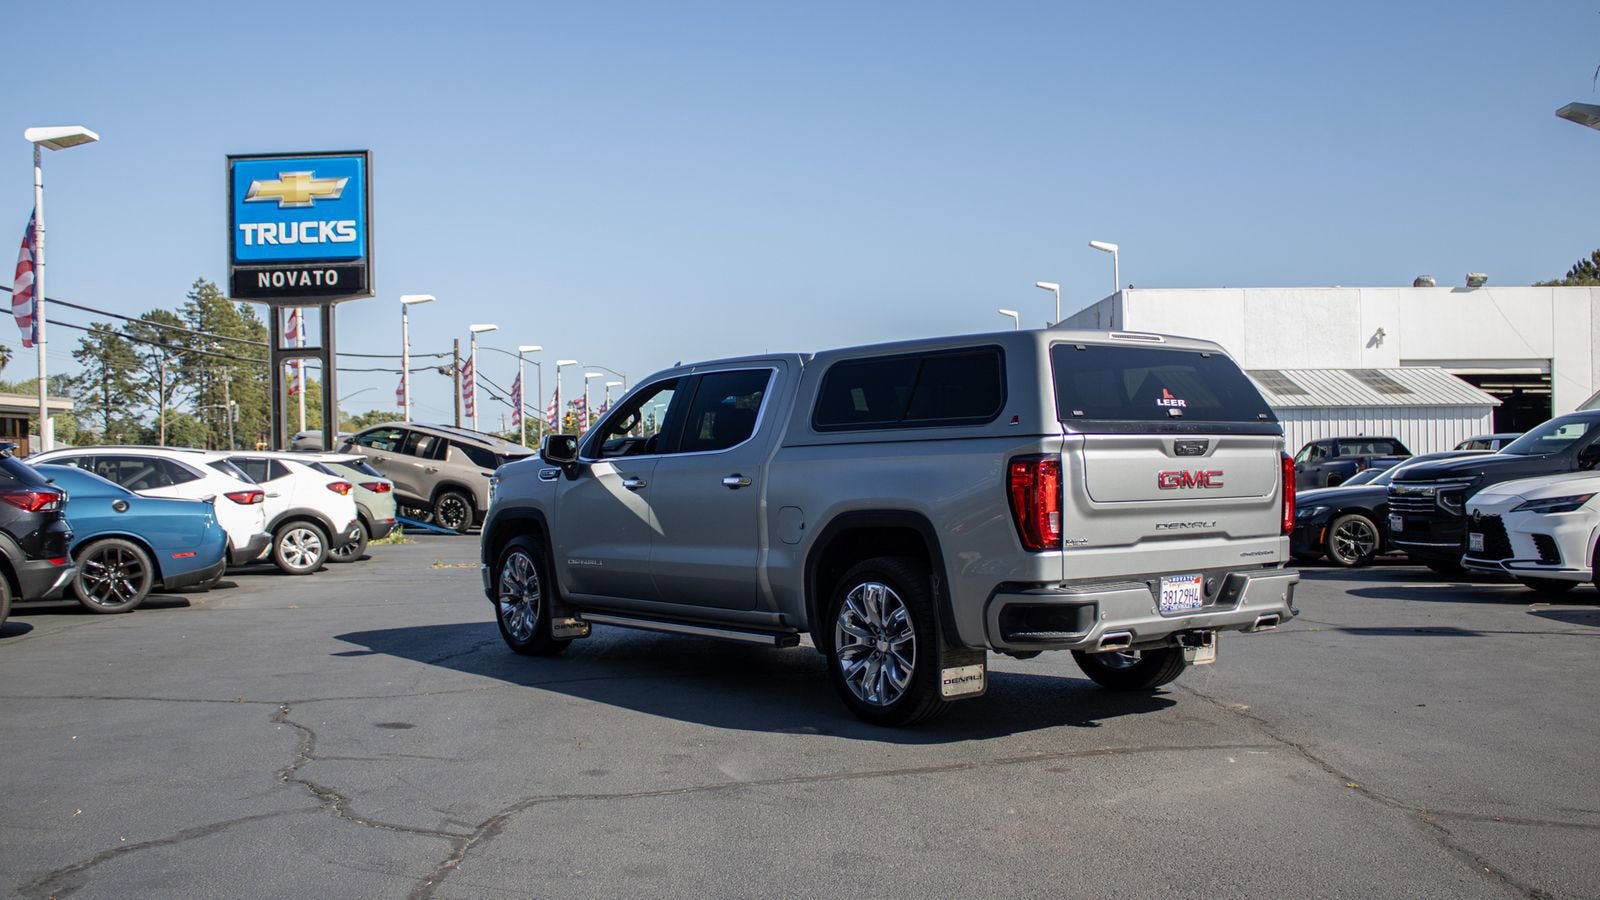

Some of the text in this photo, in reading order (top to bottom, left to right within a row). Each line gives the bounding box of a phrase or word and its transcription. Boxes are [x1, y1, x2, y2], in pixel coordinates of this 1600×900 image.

[239, 220, 357, 245] TRUCKS
[258, 269, 338, 288] NOVATO
[1157, 399, 1187, 407] LEER
[1158, 470, 1223, 489] GMC
[1156, 521, 1216, 530] DENALI
[1163, 588, 1199, 605] 38129H4
[943, 673, 982, 685] DENALI
